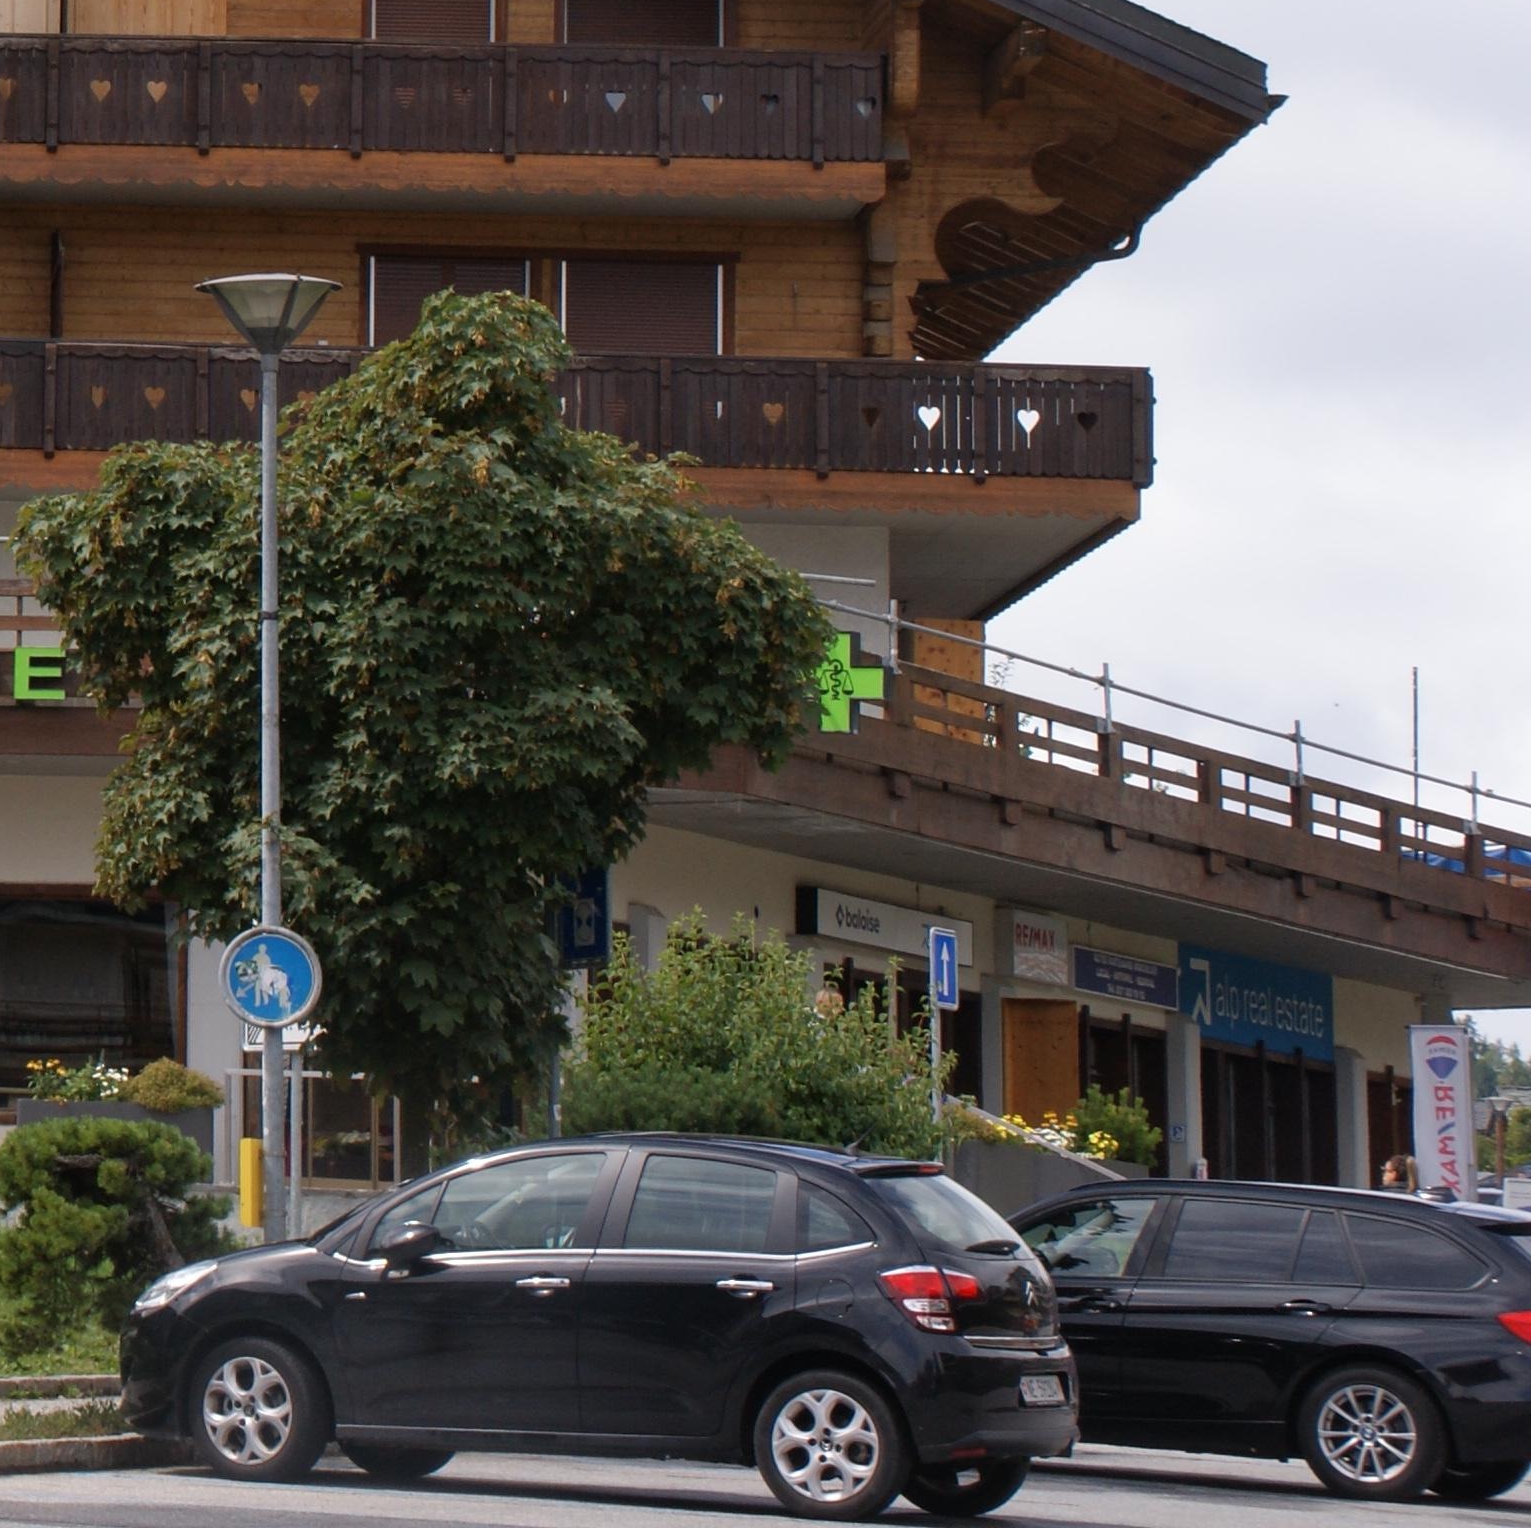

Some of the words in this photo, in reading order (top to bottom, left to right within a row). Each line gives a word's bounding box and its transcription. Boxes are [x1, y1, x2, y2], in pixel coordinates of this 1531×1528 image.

[1015, 923, 1055, 951] RE/MAX
[1215, 973, 1239, 1029] alp
[1243, 987, 1272, 1027] real
[1275, 995, 1324, 1039] estate
